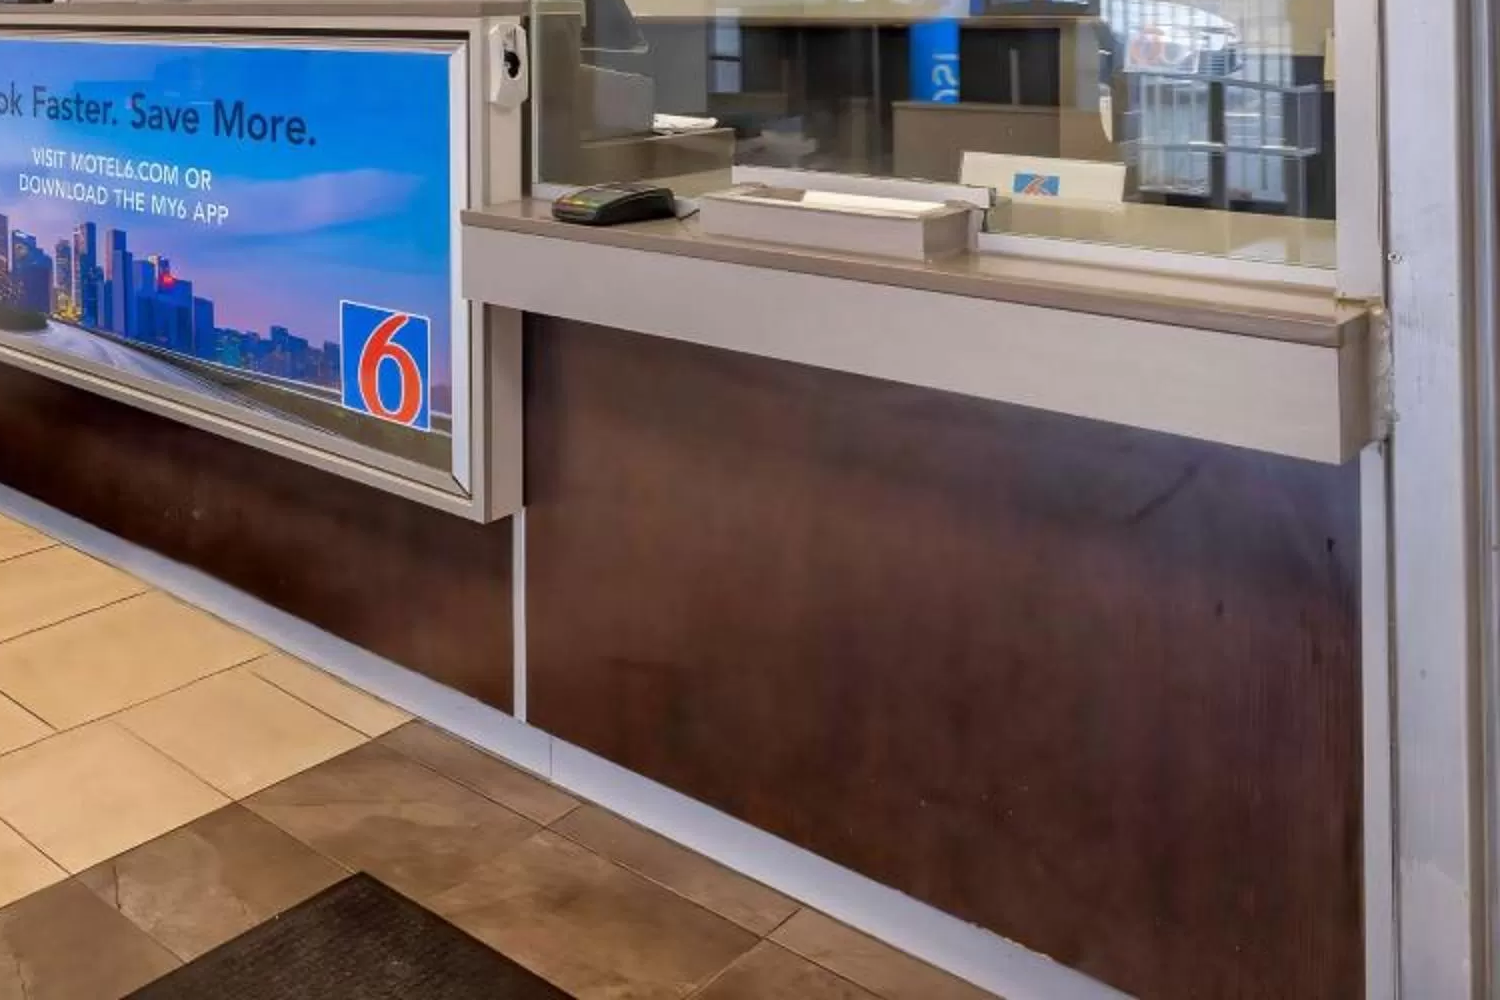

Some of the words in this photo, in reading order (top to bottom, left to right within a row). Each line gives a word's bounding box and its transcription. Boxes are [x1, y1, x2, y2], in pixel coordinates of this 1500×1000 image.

[32, 85, 117, 127] Faster.
[130, 91, 200, 135] Save
[213, 98, 317, 147] More.
[31, 147, 67, 169] VISIT
[71, 151, 179, 187] MOTEL6.COM
[185, 167, 213, 192] OR
[19, 173, 109, 206] DOWNLOAD
[113, 188, 145, 213] THE
[151, 194, 187, 220] MY6
[193, 201, 229, 227] APP
[358, 313, 422, 426] 6
